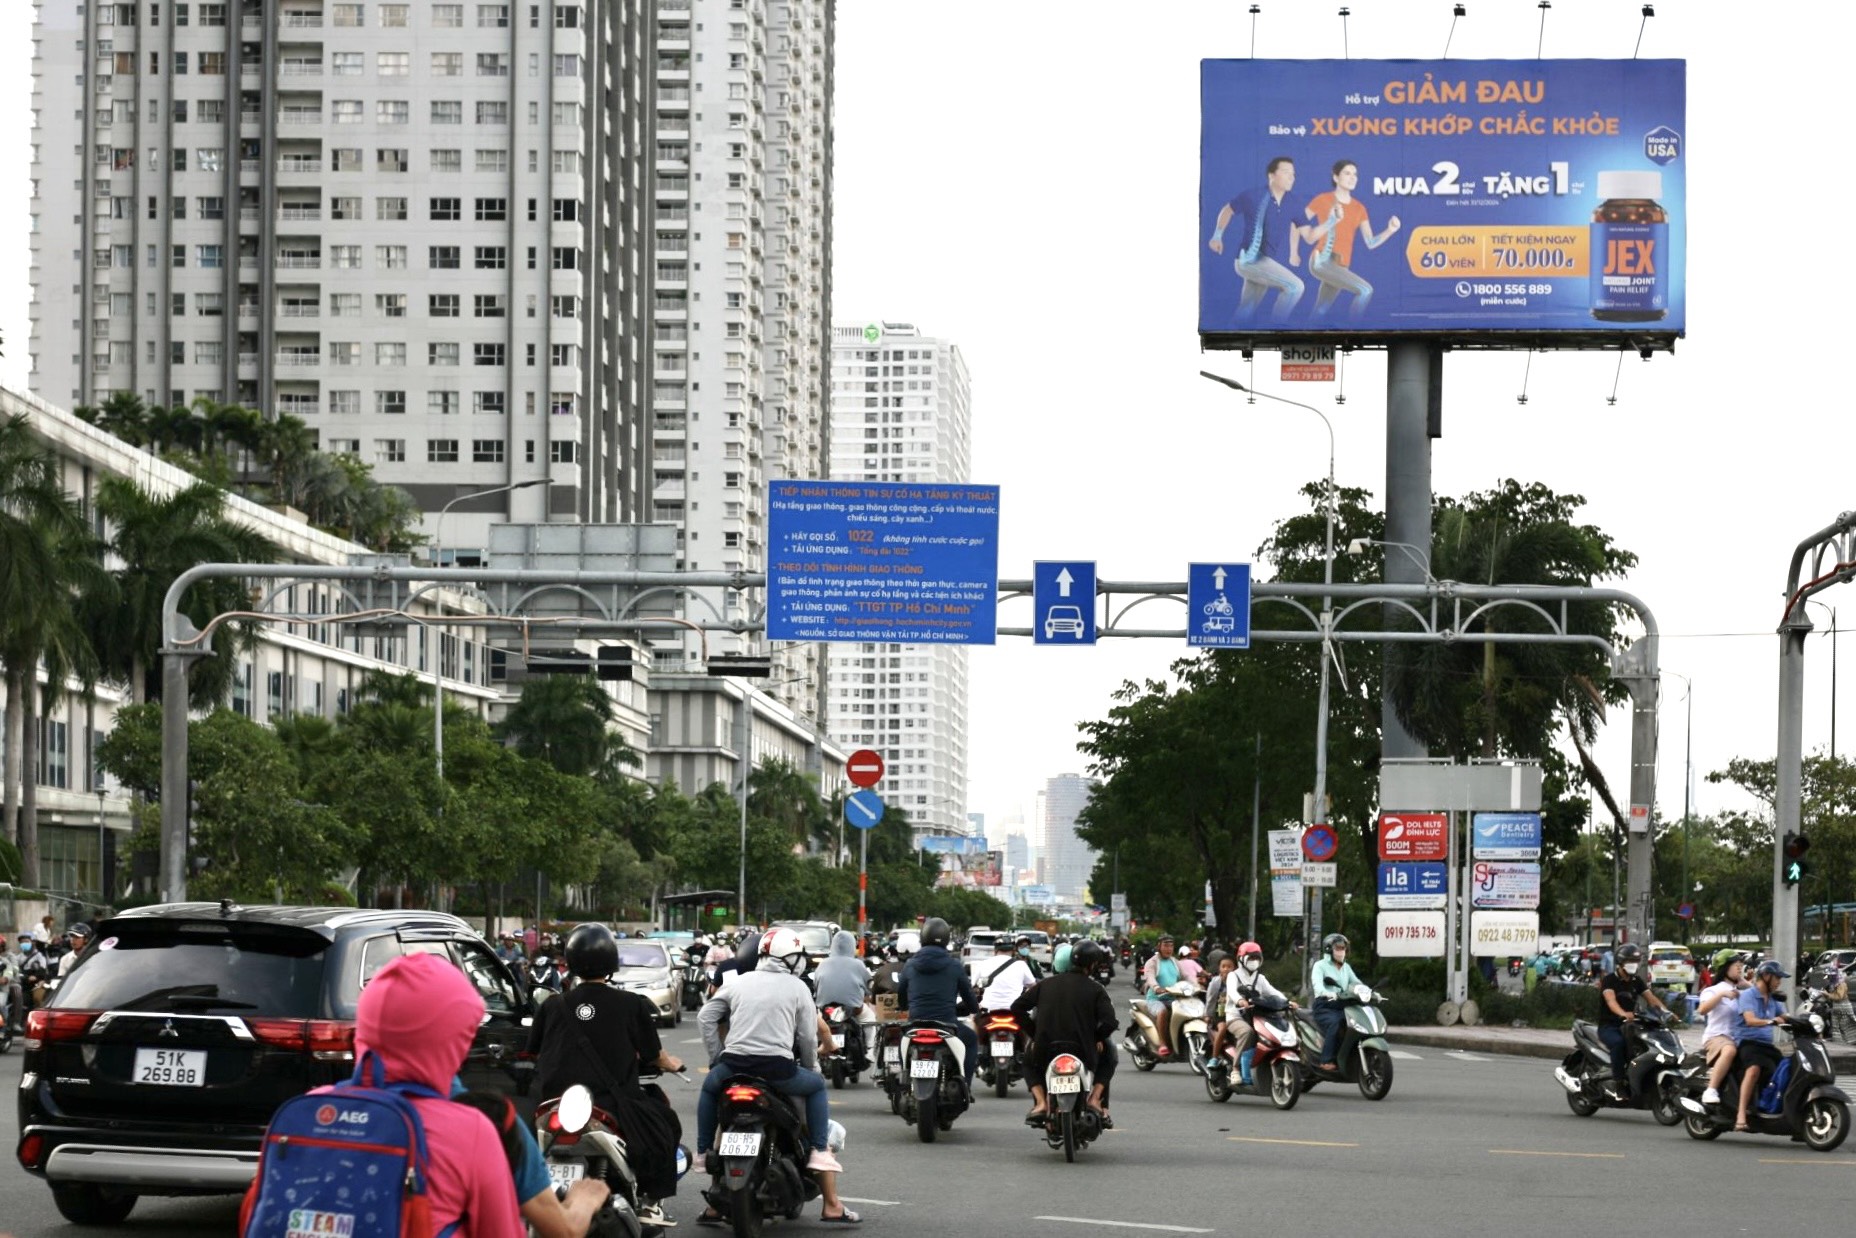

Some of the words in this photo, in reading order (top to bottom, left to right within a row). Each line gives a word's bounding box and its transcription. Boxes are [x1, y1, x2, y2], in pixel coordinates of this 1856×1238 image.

[1345, 93, 1361, 105] Hỗ
[1363, 95, 1380, 106] trợ
[1383, 72, 1467, 104] GIẢM
[1475, 80, 1545, 104] ĐAU
[1269, 124, 1291, 135] Bảo
[1293, 125, 1307, 137] vệ
[1310, 115, 1397, 136] XƯƠNG
[1404, 113, 1473, 135] KHỚP
[1479, 110, 1546, 135] CHẮC
[1552, 111, 1620, 135] KHỎE
[1648, 137, 1669, 145] Made
[1670, 137, 1678, 145] in
[1647, 145, 1677, 157] USA
[1373, 177, 1430, 195] MUA
[1432, 161, 1460, 195] 2
[1483, 172, 1550, 198] TẶNG
[1551, 162, 1569, 194] 1
[1421, 236, 1449, 245] CHAI
[1452, 235, 1476, 245] LỚN
[1491, 234, 1514, 245] TIẾT
[1516, 234, 1543, 246] KIỆM
[1546, 236, 1576, 245] NGAY
[1420, 251, 1447, 269] 60
[1450, 258, 1476, 268] VIÊN
[1492, 248, 1575, 268] 70.000đ
[1603, 240, 1655, 275] JEX
[1631, 277, 1656, 286] JOINT
[1472, 284, 1501, 295] 1800
[1504, 284, 1527, 295] 556
[1528, 284, 1552, 295] 889
[1609, 286, 1626, 294] PAIN
[1626, 286, 1649, 294] RELIEF
[1480, 297, 1503, 306] (miễn
[1505, 297, 1527, 306] cước)
[1283, 346, 1334, 363] shojiki
[780, 485, 798, 497] TIẾP
[801, 486, 827, 498] NHẬN
[831, 487, 860, 498] THÔNG
[865, 489, 879, 498] TIN
[881, 489, 893, 499] SỰ
[895, 488, 908, 499] CỐ
[910, 491, 923, 501] HẠ
[925, 488, 950, 500] TẦNG
[967, 490, 995, 502] THUẬT
[788, 501, 804, 511] tầng
[806, 503, 822, 512] giao
[848, 504, 865, 512] giao
[866, 504, 887, 513] thông
[889, 504, 907, 513] công
[931, 503, 944, 514] cấp
[946, 505, 955, 513] và
[956, 505, 975, 513] thoát
[847, 513, 868, 521] chiếu
[891, 516, 904, 524] cây
[809, 533, 824, 542] GỌI
[847, 530, 874, 542] 1022
[912, 536, 927, 544] tính
[949, 537, 968, 545] cuộc
[792, 543, 805, 553] TẢI
[806, 544, 824, 554] ỨNG
[778, 563, 801, 572] THEO
[822, 563, 841, 572] TÌNH
[844, 563, 865, 573] HÌNH
[868, 565, 890, 573] GIAO
[893, 565, 924, 574] THÔNG
[797, 575, 808, 585] đồ
[825, 579, 844, 587] trạng
[846, 580, 863, 588] giao
[864, 579, 885, 588] thông
[887, 579, 904, 587] theo
[905, 579, 920, 587] thời
[921, 580, 937, 589] gian
[781, 589, 797, 598] giao
[860, 591, 871, 599] sự
[871, 588, 882, 598] cố
[882, 591, 891, 599] hạ
[892, 590, 909, 599] tầng
[910, 590, 920, 598] và
[921, 591, 934, 599] các
[791, 601, 803, 611] TẢI
[804, 601, 823, 611] ỨNG
[889, 603, 903, 612] TP
[905, 602, 921, 613] Hồ
[924, 603, 941, 614] Chí
[828, 629, 838, 637] SỞ
[857, 630, 881, 638] THÔNG
[881, 631, 897, 639] VẬN
[898, 630, 909, 639] TẢI
[932, 631, 944, 639] CHÍ
[1426, 829, 1441, 837] LỰC
[1502, 823, 1535, 832] PEACE
[1385, 867, 1408, 886] ila
[1385, 927, 1403, 938] 0919
[1406, 927, 1420, 938] 735
[1422, 926, 1436, 938] 736
[1478, 929, 1499, 942] 0922
[1501, 929, 1512, 941] 48
[1515, 929, 1536, 942] 7979
[156, 1052, 185, 1066] 51K
[142, 1067, 196, 1083] 269.88
[338, 1111, 369, 1124] AEG
[728, 1134, 754, 1144] 60-H5
[722, 1145, 757, 1155] 206.78
[550, 1165, 576, 1179] 5-81
[290, 1211, 351, 1235] STEAM
